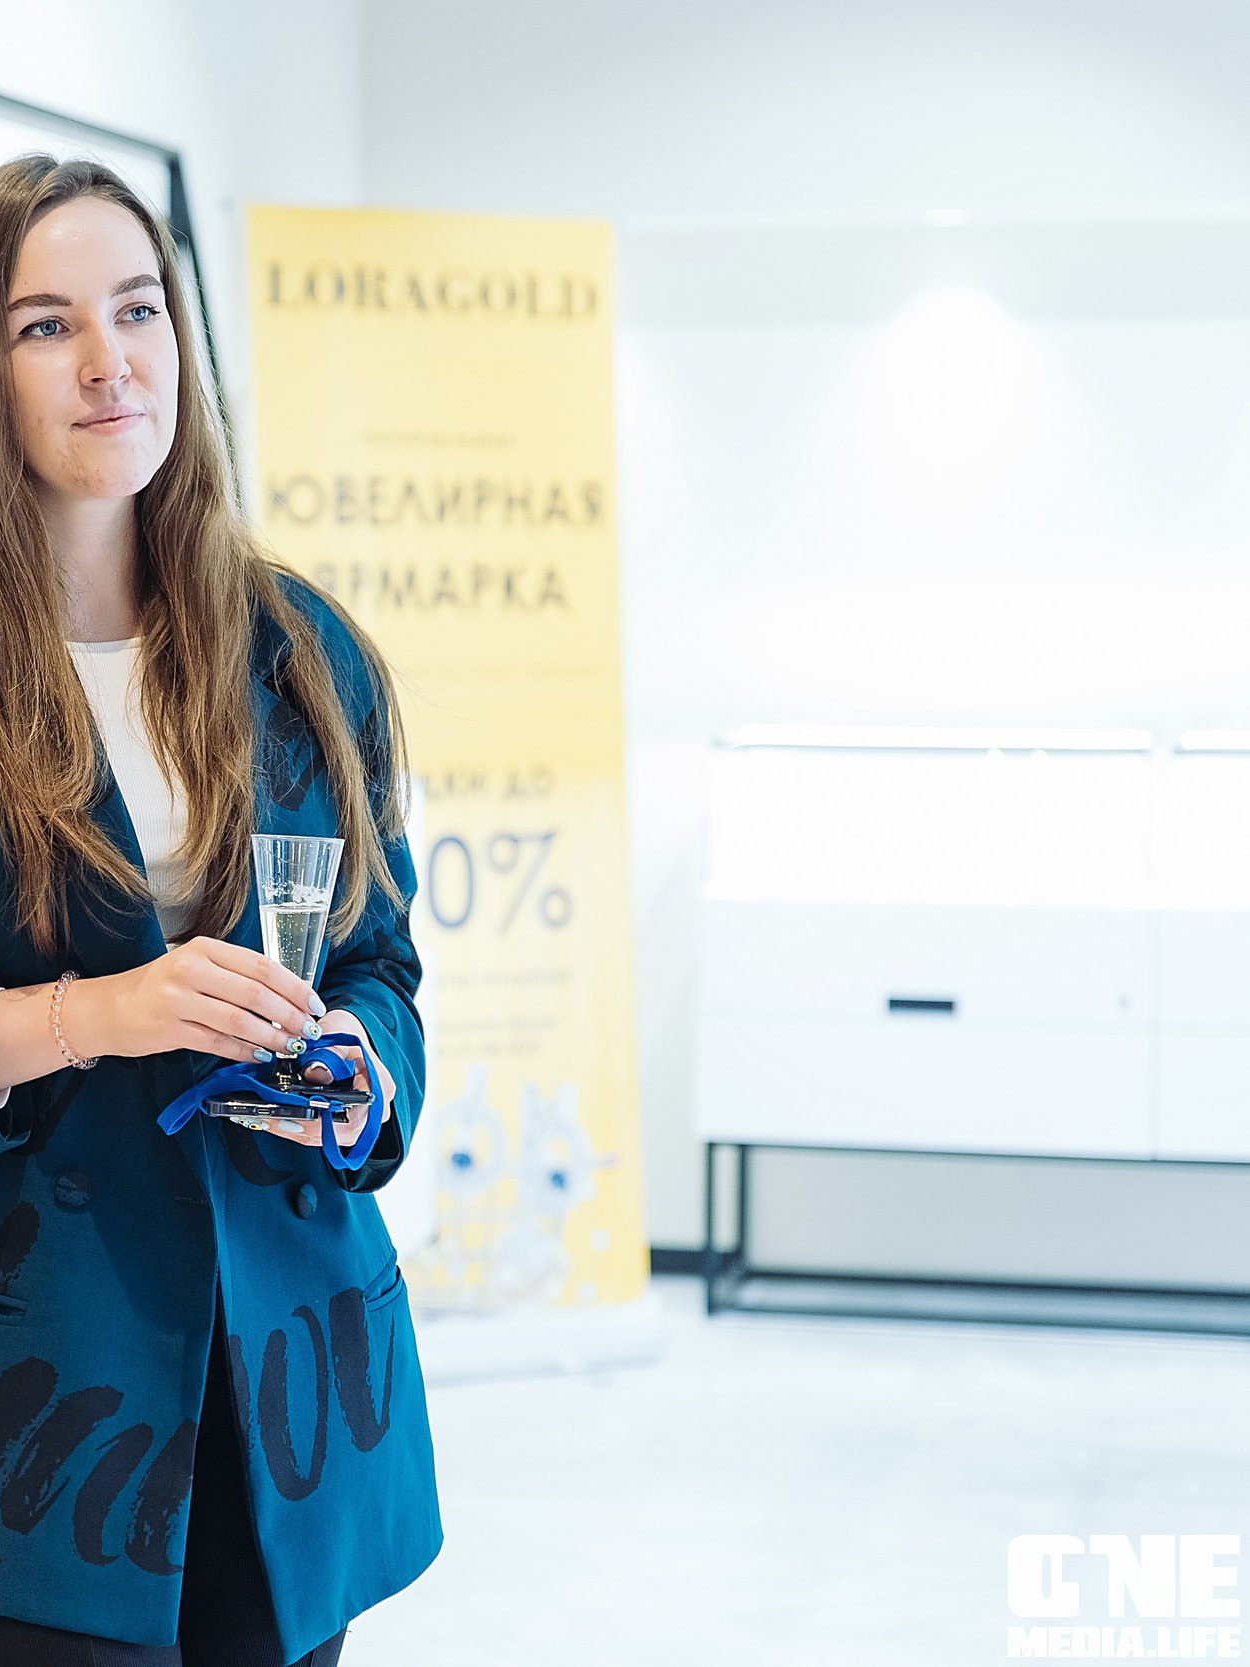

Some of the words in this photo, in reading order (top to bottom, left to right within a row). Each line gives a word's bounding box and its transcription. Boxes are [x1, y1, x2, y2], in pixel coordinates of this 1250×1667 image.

[266, 260, 600, 319] LORAGOLD
[268, 474, 607, 527] ЮВЕЛИРНАЯ
[427, 828, 574, 936] 0%
